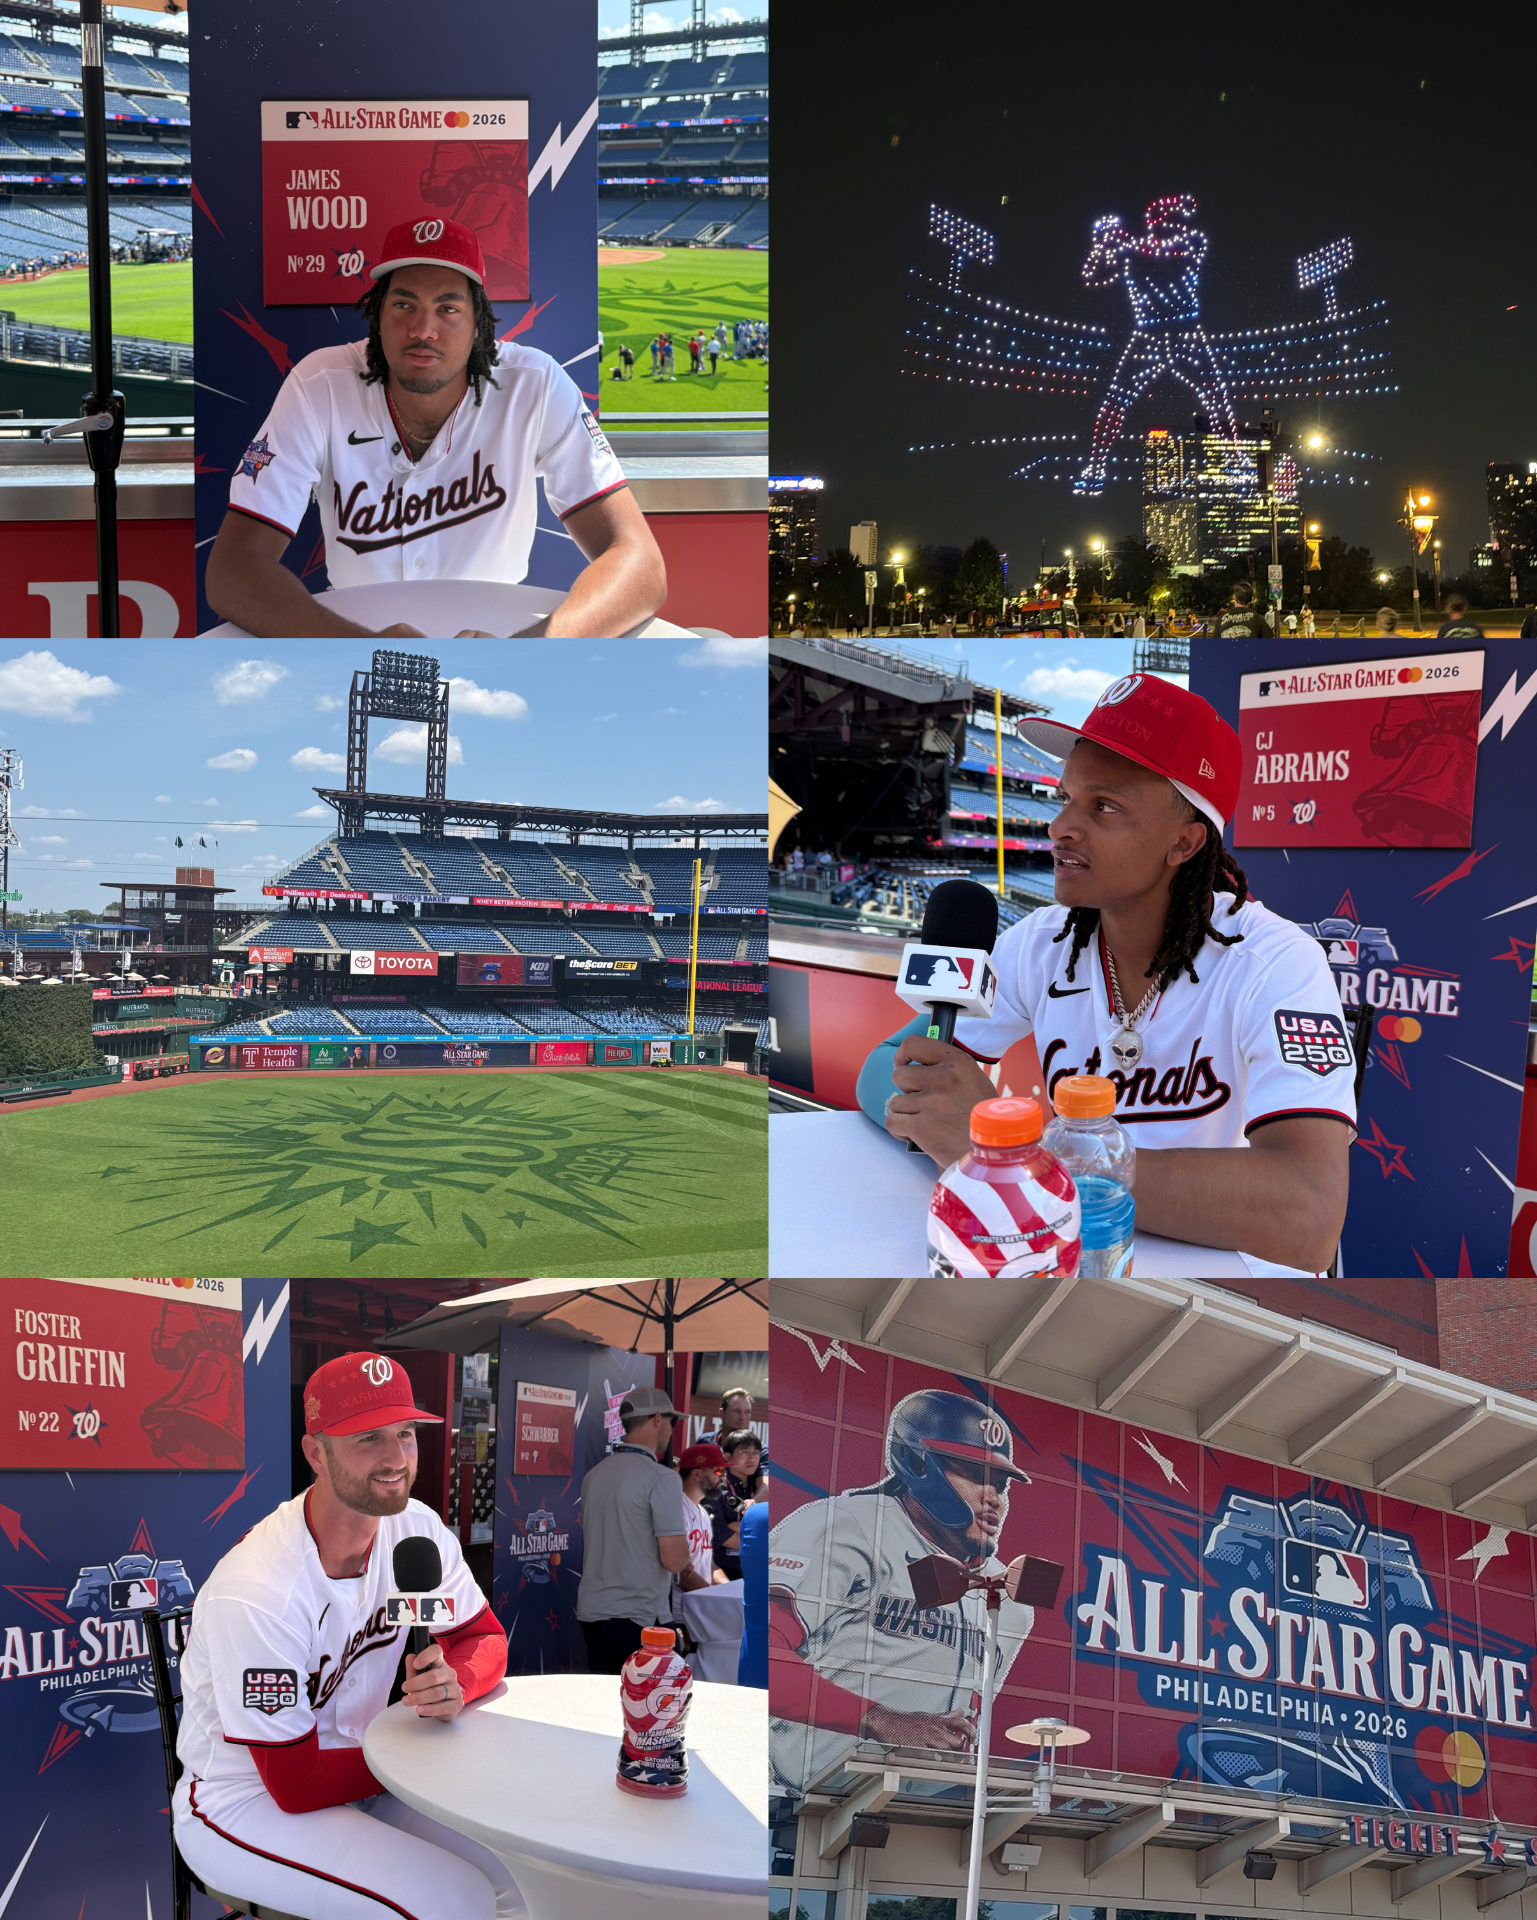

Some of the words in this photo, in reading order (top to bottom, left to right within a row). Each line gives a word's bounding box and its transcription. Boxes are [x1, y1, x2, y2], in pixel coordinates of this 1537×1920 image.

[321, 108, 353, 129] ALL
[356, 108, 396, 129] STAR
[399, 107, 442, 129] GAME
[472, 113, 506, 125] 2026
[285, 169, 341, 190] JAMES
[286, 195, 367, 230] WOOD
[305, 254, 325, 273] 29
[334, 449, 506, 536] Nationals
[1288, 675, 1315, 694] ALL
[1314, 672, 1352, 692] STAR
[1355, 668, 1396, 689] GAME
[1425, 665, 1460, 680] 2026
[1255, 731, 1274, 750] CJ
[1253, 750, 1350, 785] ABRAMS
[1266, 804, 1276, 821] 5
[423, 895, 451, 903] BAKERY
[742, 907, 757, 915] GAME
[378, 957, 433, 970] TOYOTA
[569, 959, 613, 969] theScore
[615, 961, 636, 970] BET
[732, 981, 764, 993] LEAGUE
[1365, 968, 1461, 1017] GAME
[122, 1003, 150, 1012] NUTRAFOL
[185, 1007, 216, 1016] NUTRAFOL
[1279, 1015, 1341, 1036] USA
[262, 1046, 298, 1059] Temple
[262, 1057, 295, 1067] Health
[456, 1049, 473, 1060] STAR
[473, 1049, 490, 1060] GAME
[1283, 1043, 1351, 1065] 250
[1004, 1231, 1035, 1244] BETTER
[1035, 1223, 1056, 1238] THAN
[196, 1278, 225, 1293] 2026
[14, 1308, 82, 1340] FOSTER
[16, 1341, 126, 1388] GRIFFIN
[39, 1411, 60, 1433] 22
[521, 1425, 559, 1444] SCHWARBER
[509, 1534, 528, 1556] ALL
[527, 1534, 548, 1553] STAR
[547, 1532, 569, 1551] GAME
[0, 1625, 75, 1681] ALL
[79, 1616, 151, 1667] STA
[1076, 1554, 1216, 1671] ALL
[1227, 1586, 1383, 1701] STAR
[1388, 1623, 1534, 1728] GAME
[39, 1665, 139, 1692] PHILADELPHIA
[246, 1672, 295, 1685] USA
[244, 1692, 296, 1706] 250
[1155, 1674, 1336, 1727] PHILADELPHIA
[1354, 1710, 1408, 1739] 2026
[1345, 1815, 1461, 1857] TICKET
